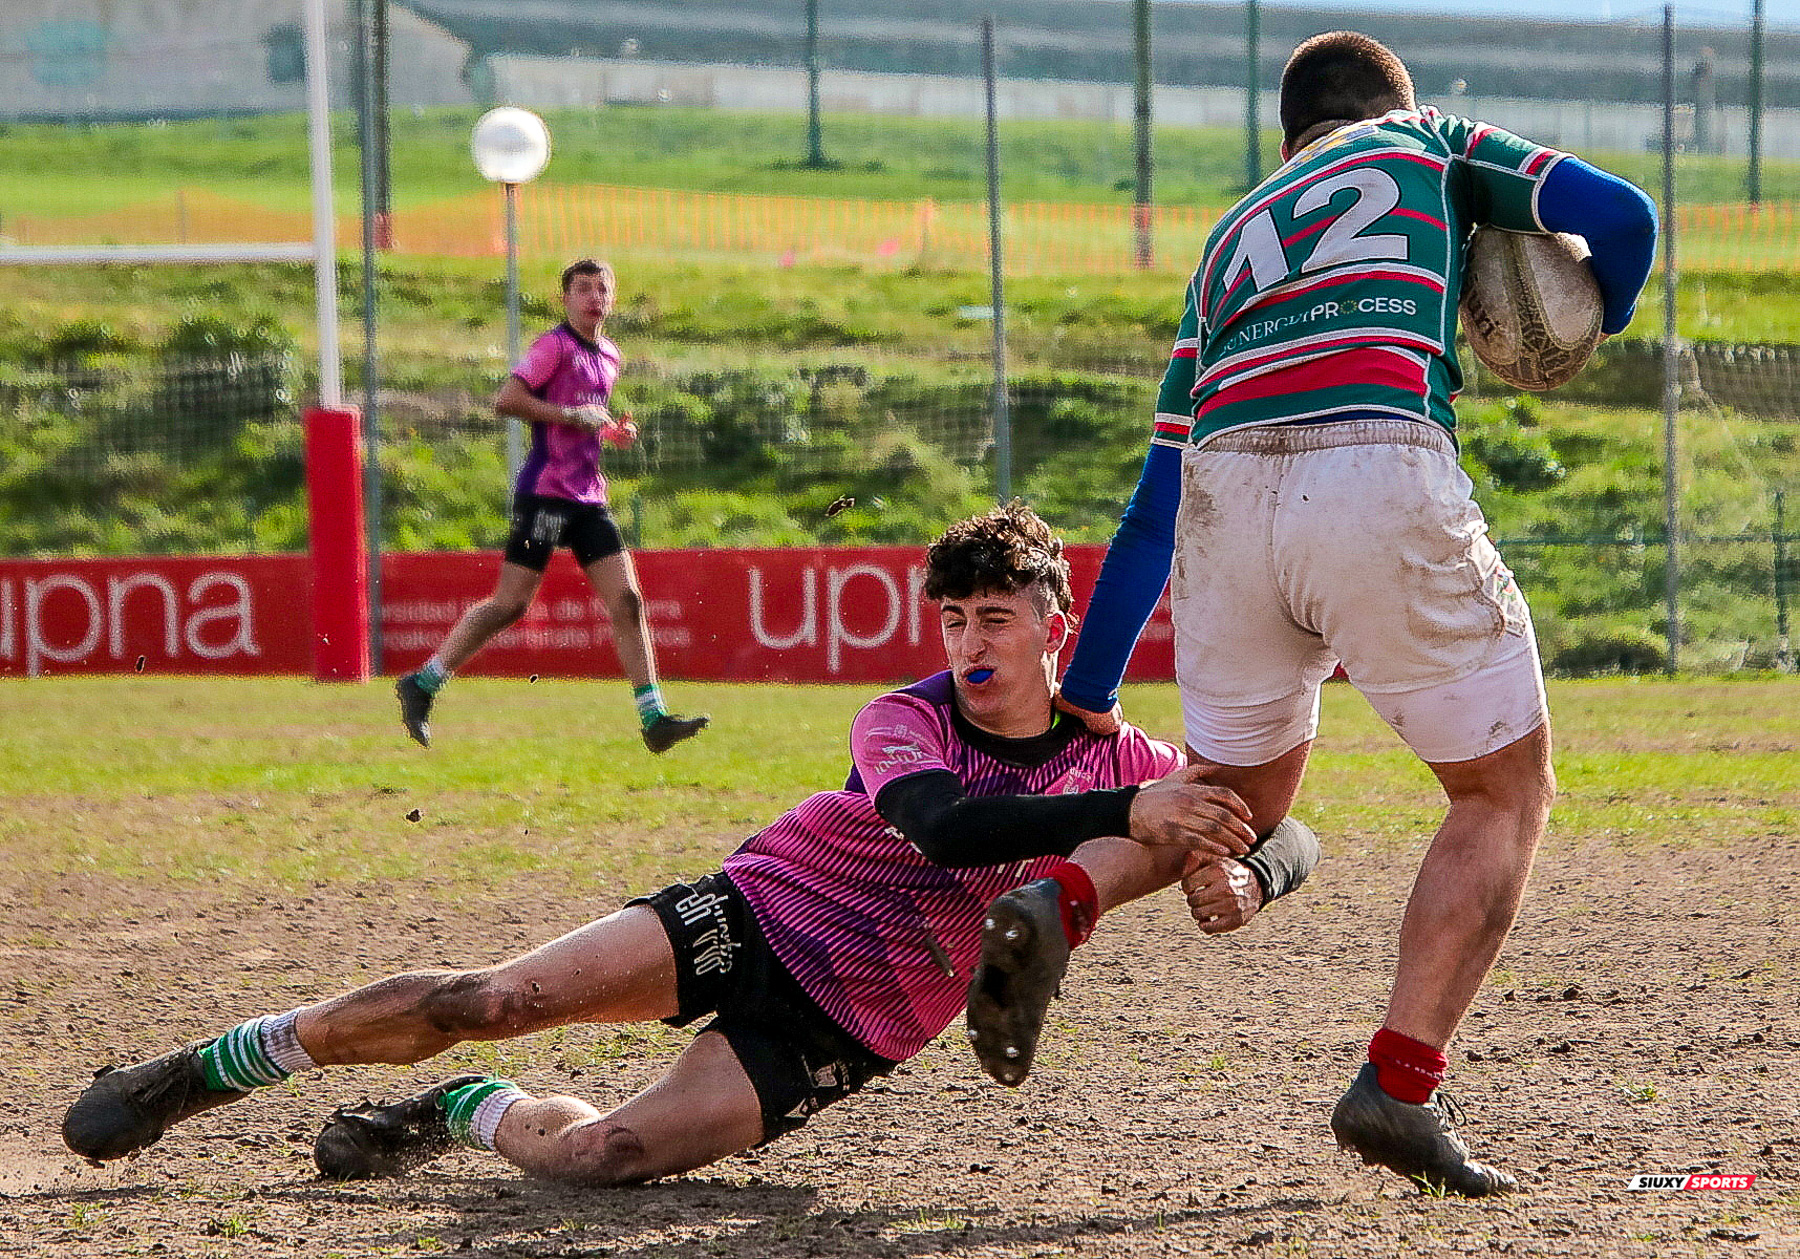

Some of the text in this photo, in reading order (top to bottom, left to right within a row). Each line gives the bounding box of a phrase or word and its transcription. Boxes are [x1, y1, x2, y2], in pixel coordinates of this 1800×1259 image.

[1222, 167, 1409, 293] 12
[0, 572, 261, 678] pna
[748, 562, 924, 674] up
